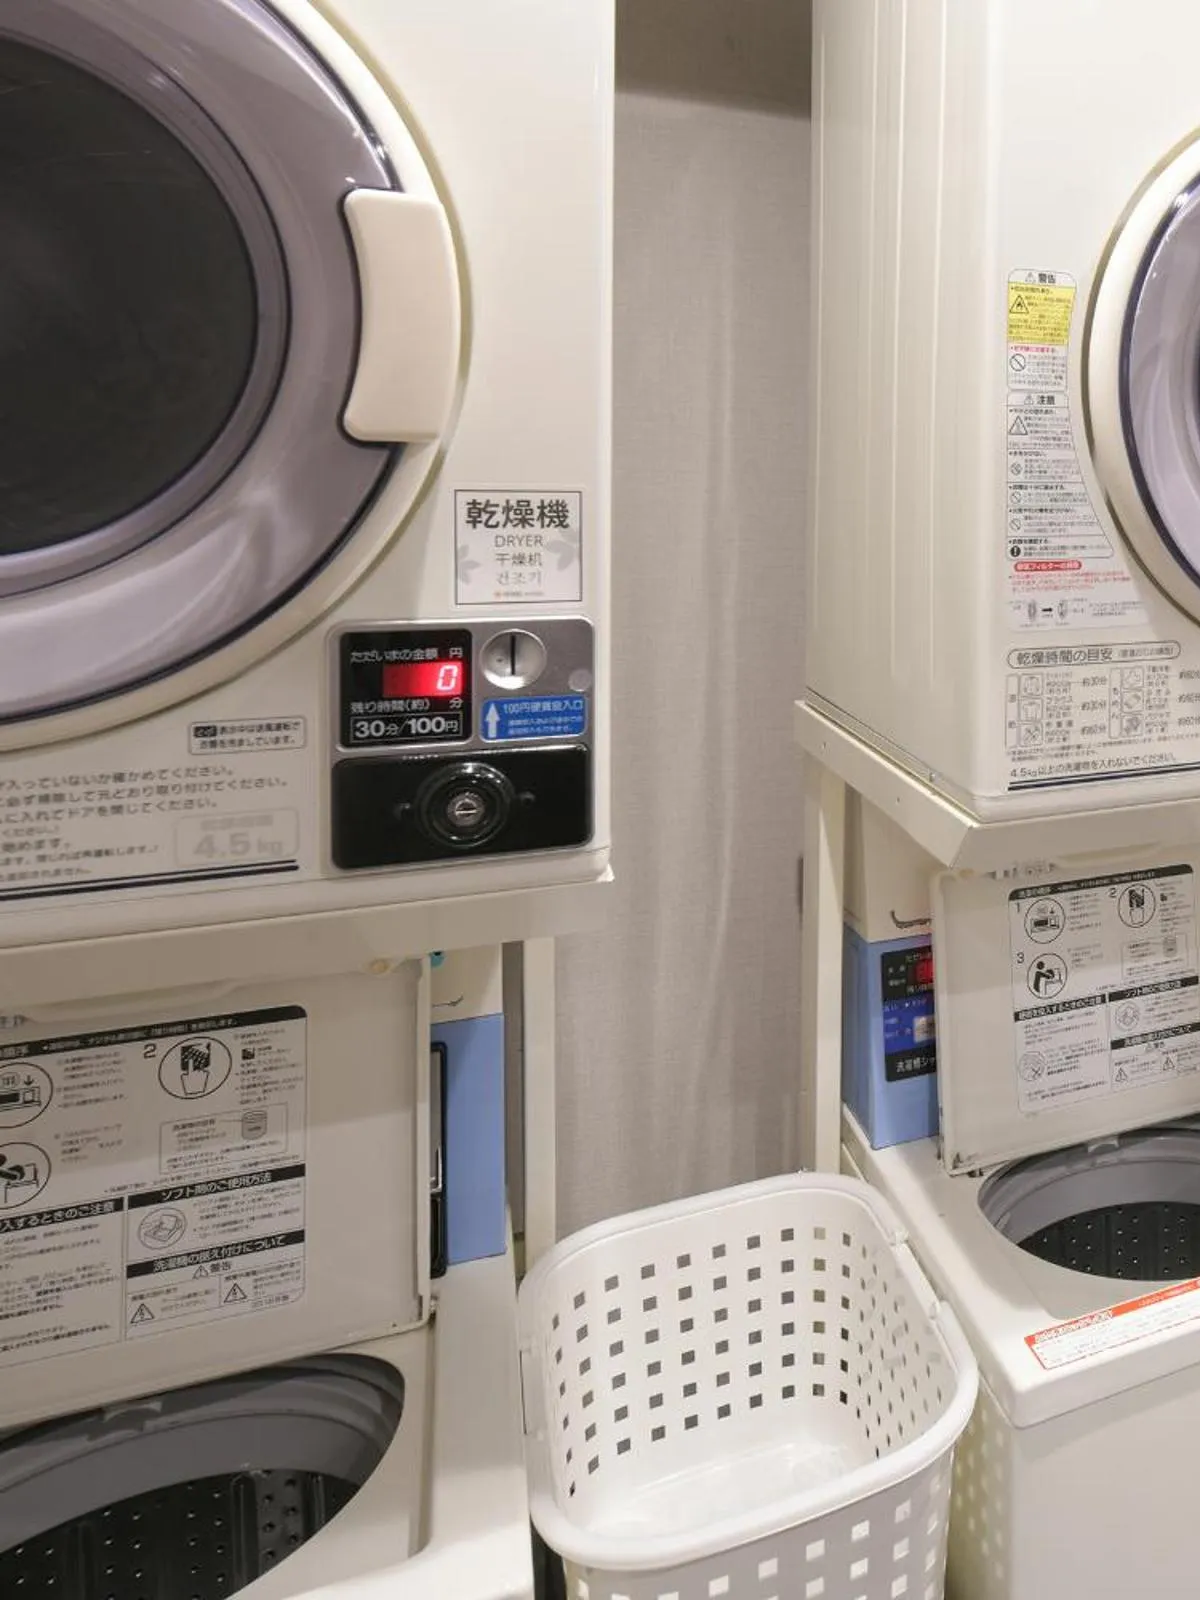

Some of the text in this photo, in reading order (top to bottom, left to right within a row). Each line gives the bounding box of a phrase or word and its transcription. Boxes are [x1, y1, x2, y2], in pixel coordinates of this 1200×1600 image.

[465, 499, 570, 530] 乾燥機
[494, 534, 544, 548] DRYER
[495, 552, 543, 567] 干燥机
[437, 664, 459, 691] 0
[355, 716, 459, 738] 30分/100円
[143, 1043, 157, 1059] 2
